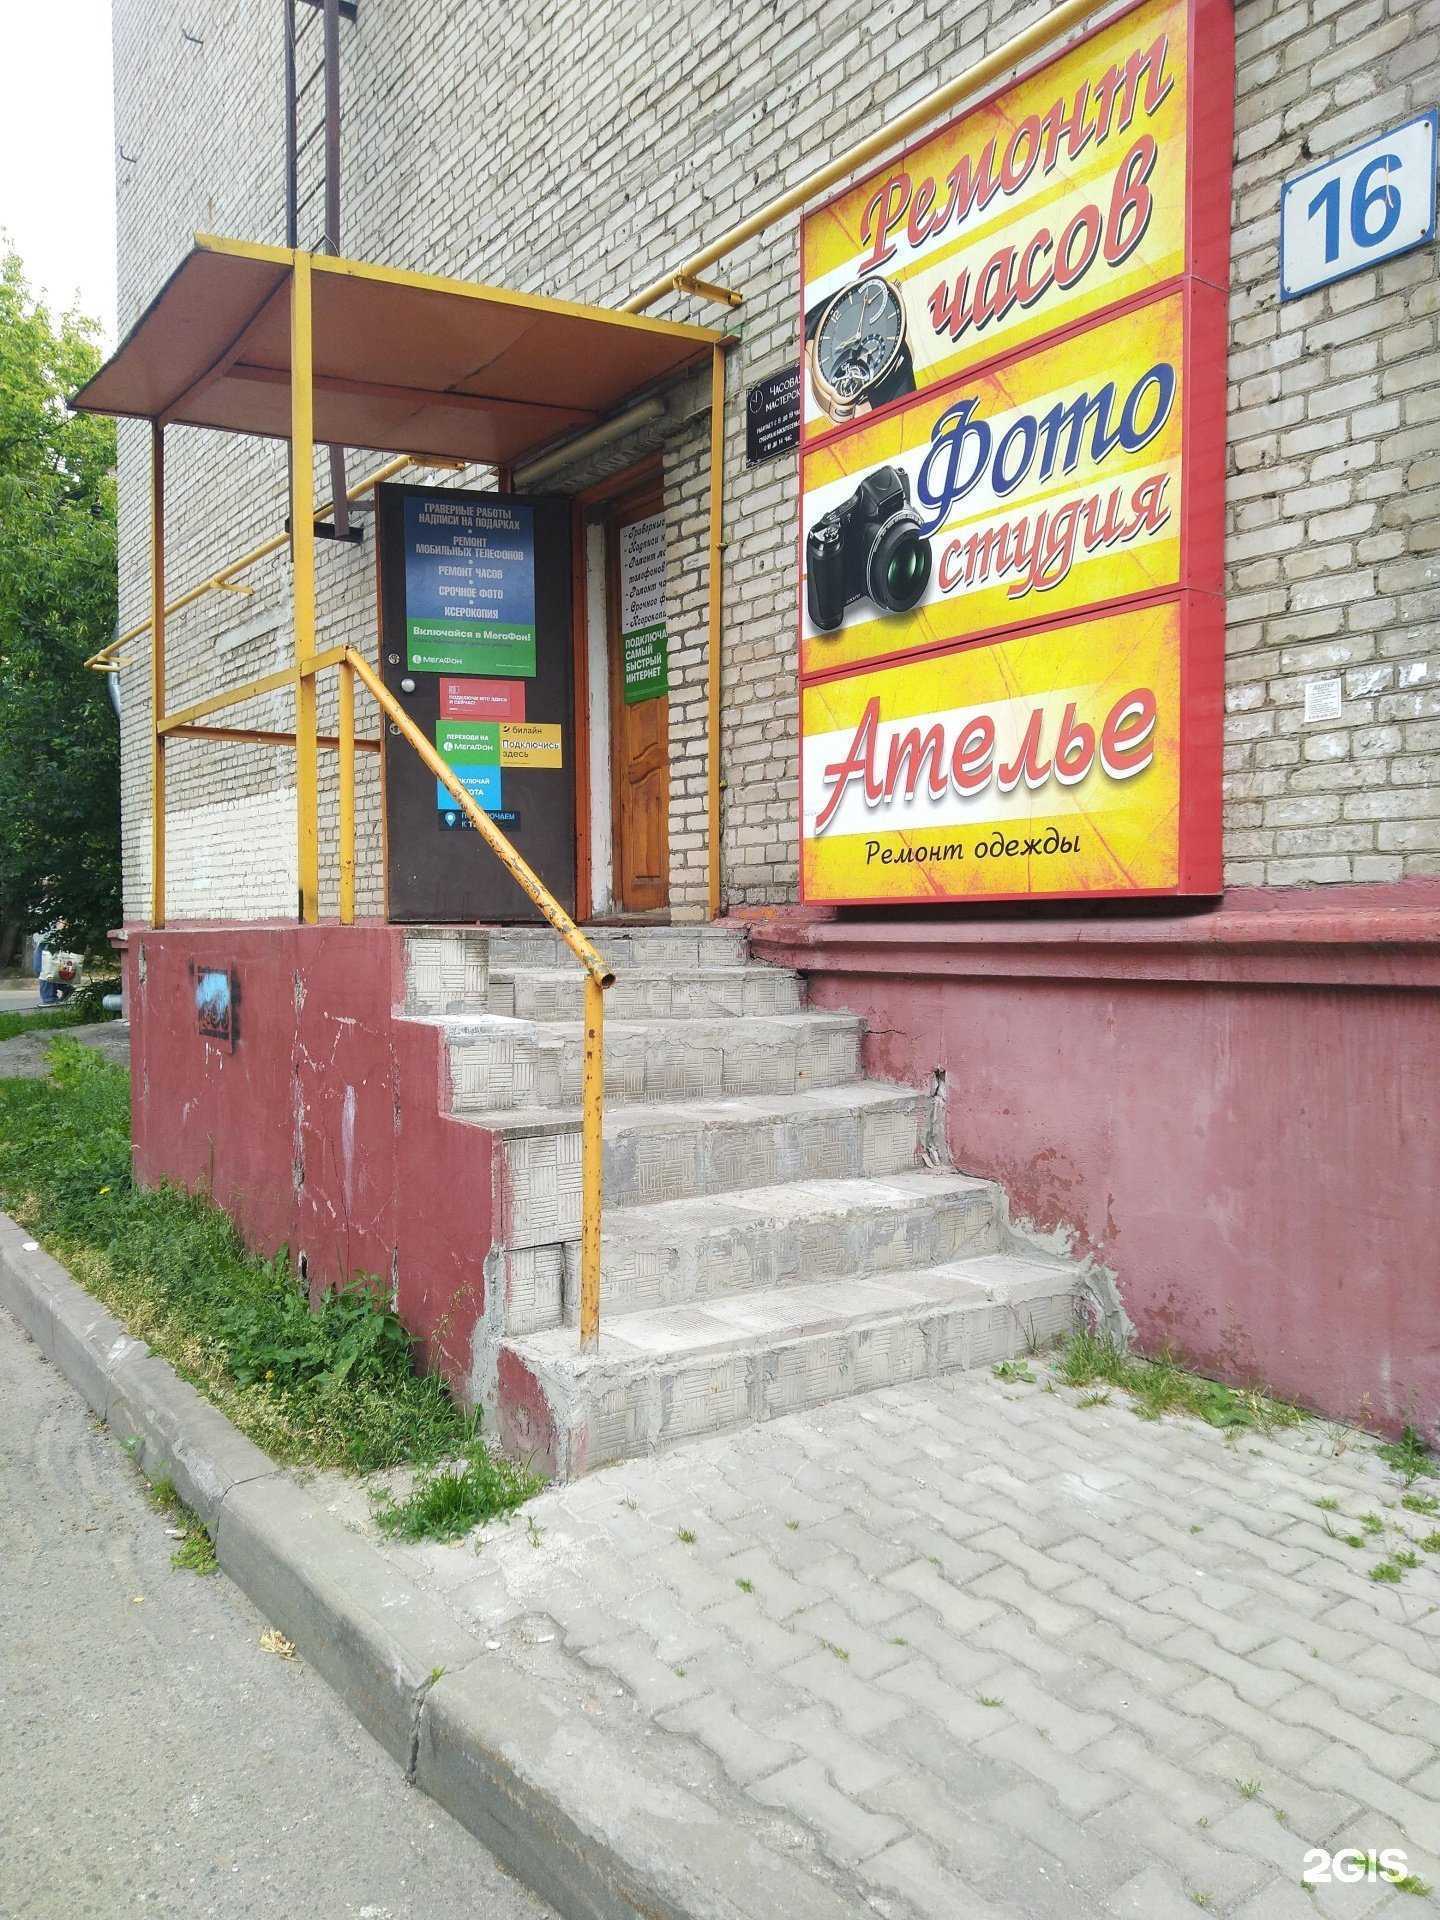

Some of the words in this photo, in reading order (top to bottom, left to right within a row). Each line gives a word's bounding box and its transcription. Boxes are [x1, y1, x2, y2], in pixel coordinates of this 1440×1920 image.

[857, 33, 1175, 276] Ремонт
[1308, 153, 1403, 264] 16
[928, 134, 1158, 342] часов
[765, 388, 801, 413] МАСТЕРСК
[917, 362, 1177, 540] Фото
[424, 503, 474, 516] ГРАВЕРНЫЕ
[476, 507, 511, 520] РАБОТЫ
[418, 513, 459, 526] НАДПИСИ
[461, 518, 473, 527] НА
[475, 518, 520, 530] ПОДАРКАХ
[453, 535, 488, 547] РЕМОНТ
[938, 472, 1172, 600] студия
[415, 543, 472, 557] МОБИЛЬНЫХ
[475, 548, 524, 561] ТЕЛЕФОНОВ
[438, 565, 473, 577] РЕМОНТ
[475, 567, 503, 579] ЧАСОВ
[438, 585, 478, 598] СРОЧНОЕ
[479, 588, 504, 600] ФОТО
[444, 606, 499, 619] КСЕРОКОПИЯ
[413, 626, 473, 639] Включайся
[483, 630, 531, 642] МегаФон!
[625, 642, 653, 661] САМЫЙ
[625, 652, 662, 672] БЫСТРЫЙ
[626, 666, 661, 684] ИНТЕРНЕТ
[512, 726, 542, 735] билайн
[502, 739, 560, 750] Подключись
[502, 750, 529, 759] здесь
[815, 687, 1157, 835] Ателье
[458, 777, 490, 785] КЛЮЧАЙ
[866, 840, 964, 865] Ремонт
[974, 827, 1081, 858] одежды
